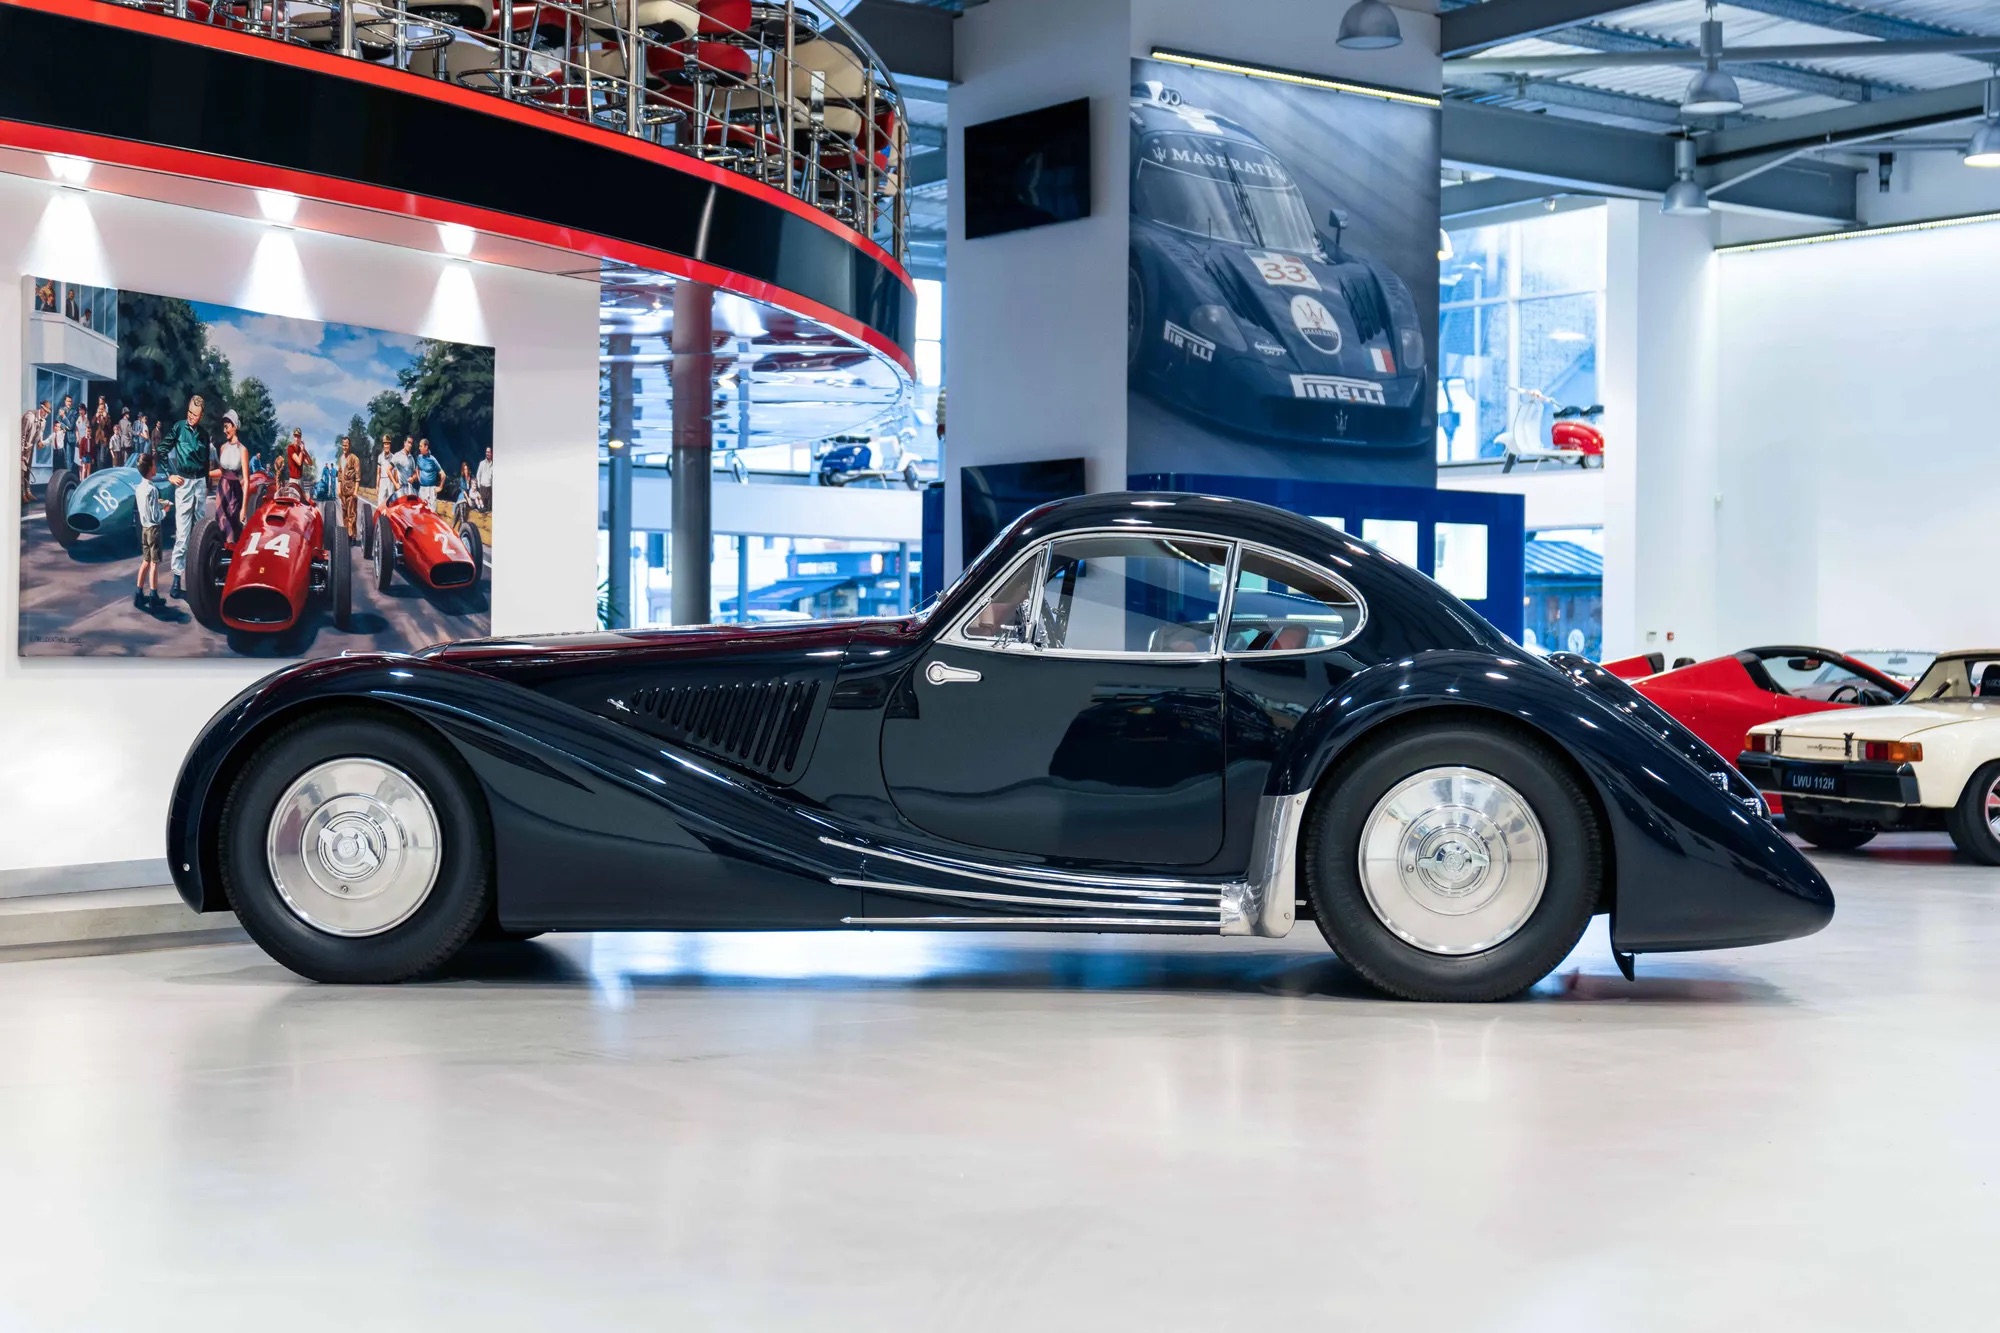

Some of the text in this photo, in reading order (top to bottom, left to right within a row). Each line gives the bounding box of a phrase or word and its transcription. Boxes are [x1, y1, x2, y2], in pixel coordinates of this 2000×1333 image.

[1172, 148, 1276, 178] MASERATI
[1263, 262, 1307, 283] 33
[1163, 319, 1217, 362] PIRLLI
[1304, 328, 1338, 339] MASERATI
[1289, 373, 1386, 405] PIRELLI
[93, 489, 119, 512] 18
[241, 531, 291, 558] 14
[434, 533, 457, 555] 2
[1792, 774, 1835, 790] LWU 112H
